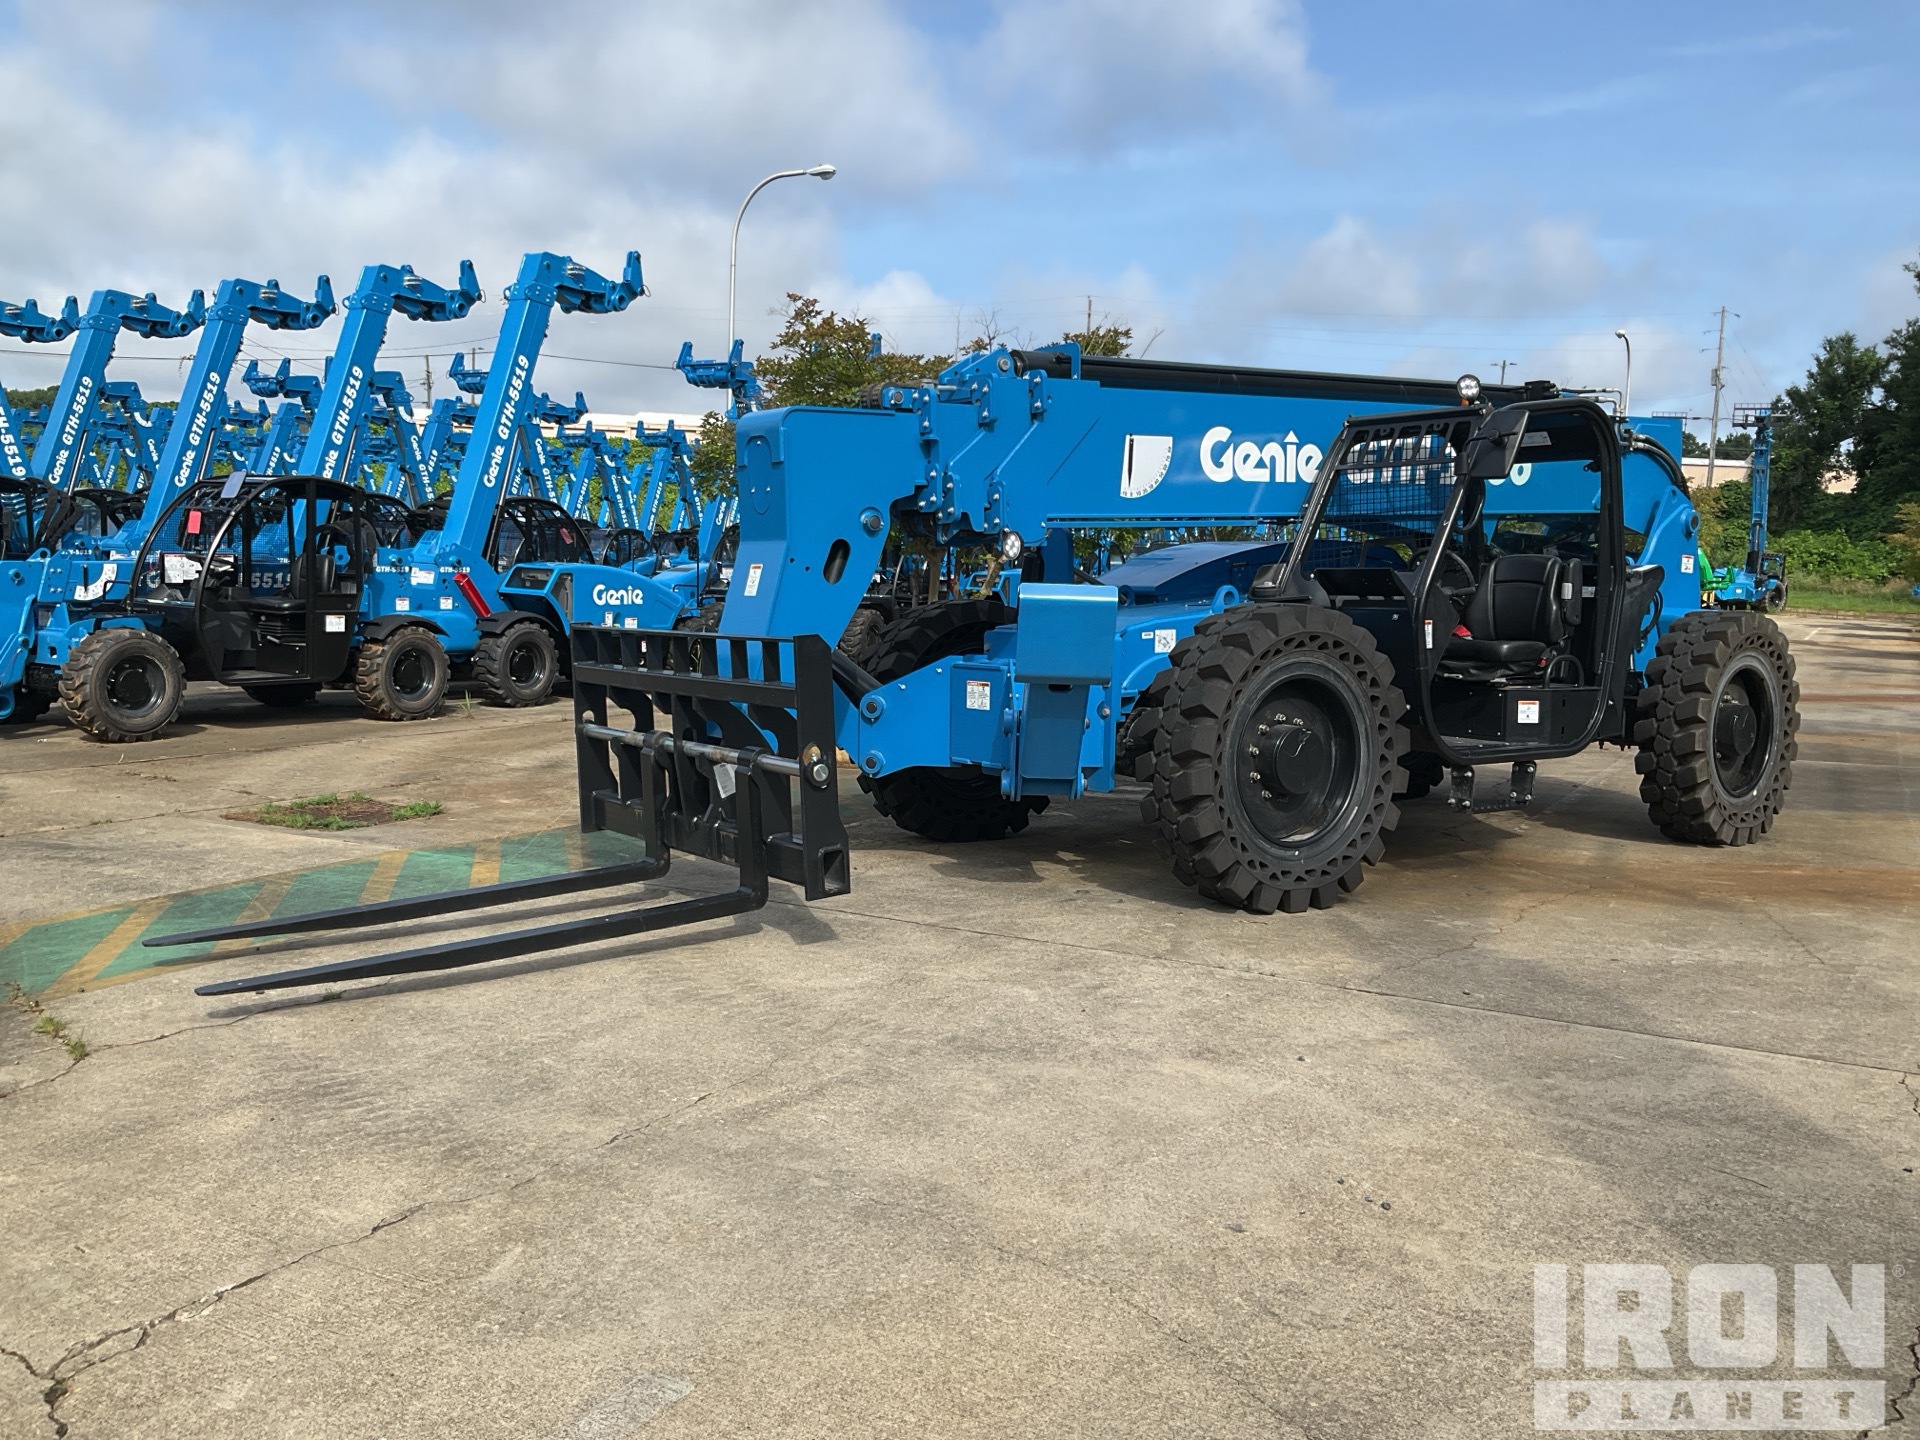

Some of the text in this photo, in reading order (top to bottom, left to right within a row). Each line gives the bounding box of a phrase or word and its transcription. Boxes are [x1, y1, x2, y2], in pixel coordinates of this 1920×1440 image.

[48, 376, 94, 484] Genie GTH-5519
[174, 371, 221, 488] Genie GTH-5519
[331, 365, 364, 446] GTH-5519
[483, 354, 529, 488] Genie GTH-5519
[1200, 426, 1322, 483] Genie
[592, 584, 644, 606] Genie
